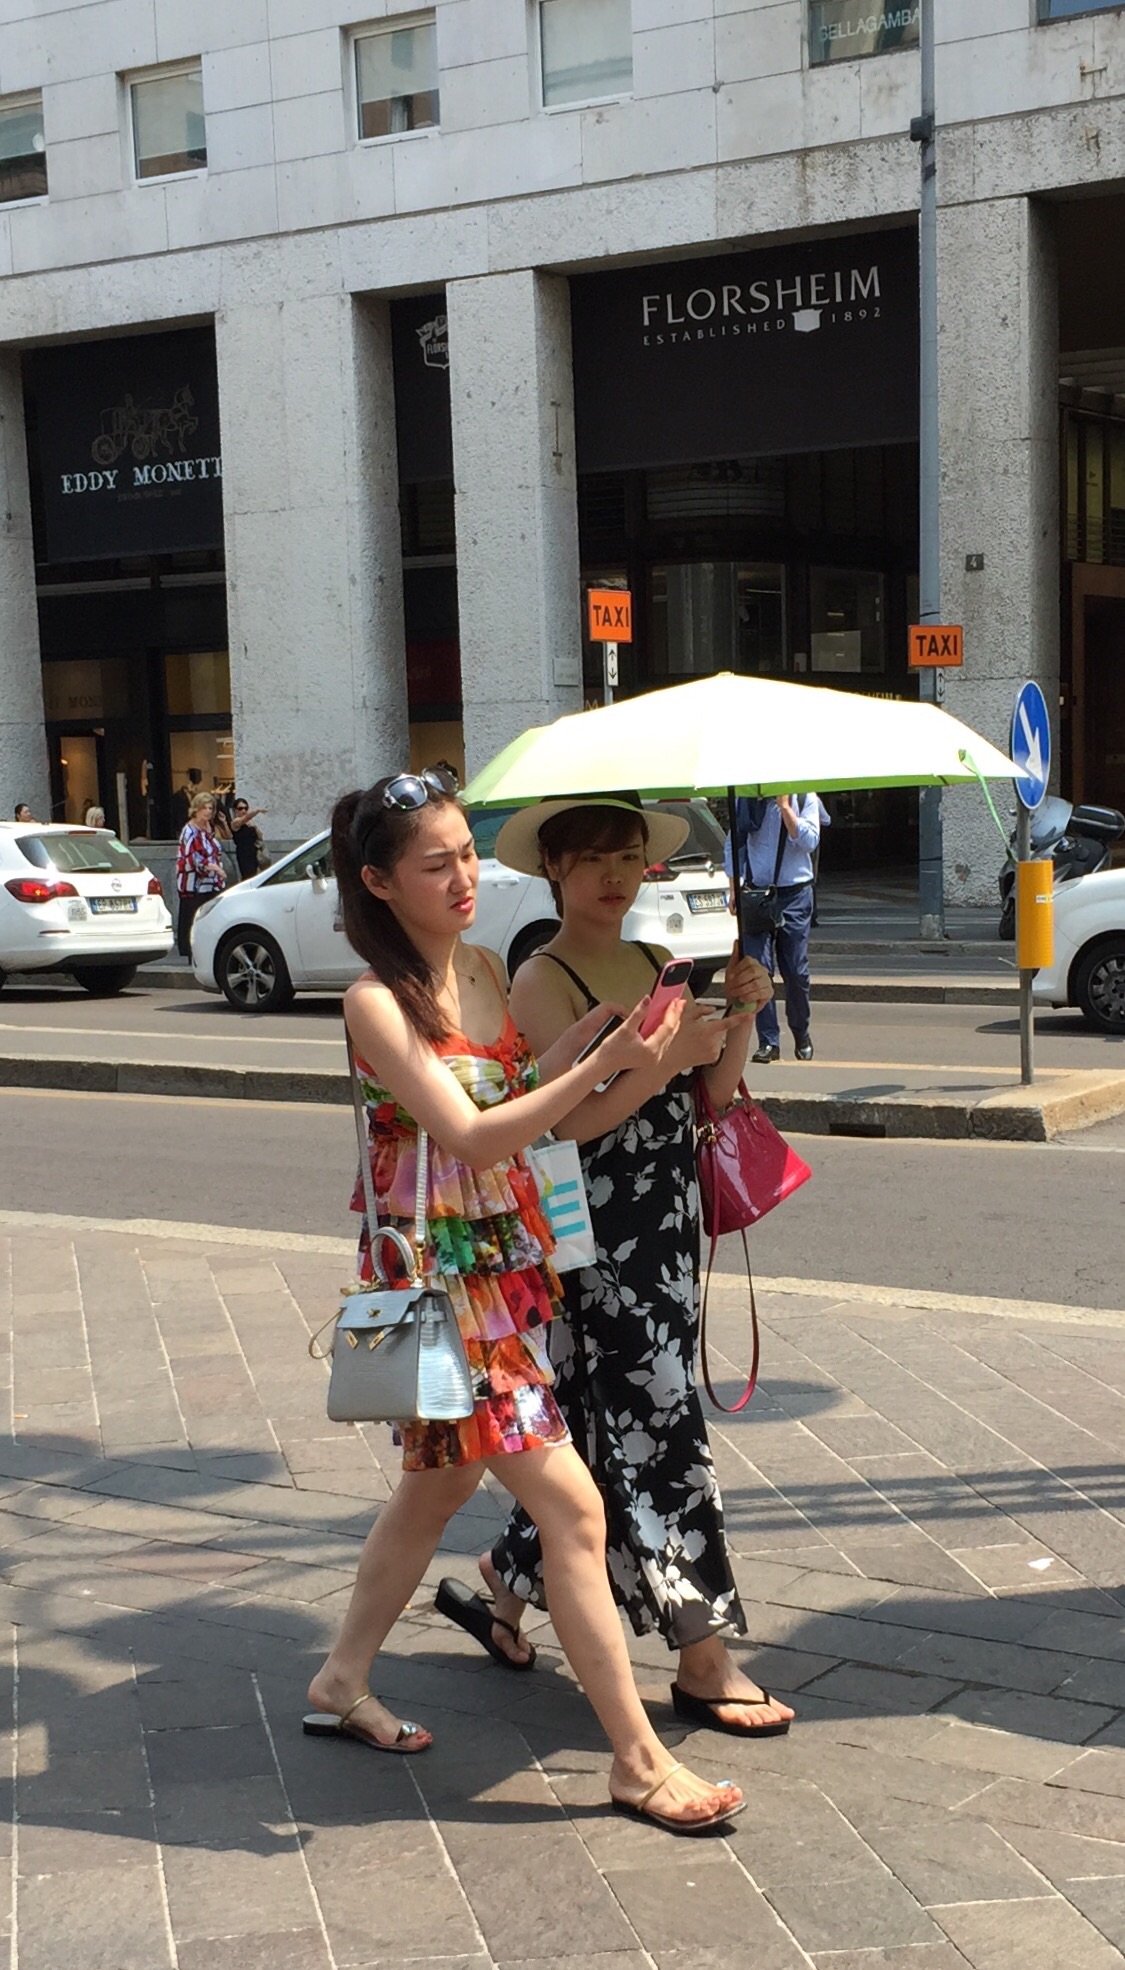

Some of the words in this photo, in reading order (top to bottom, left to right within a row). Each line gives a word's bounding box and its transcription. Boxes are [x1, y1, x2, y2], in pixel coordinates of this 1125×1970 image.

[642, 266, 881, 326] FLORSHEIM
[643, 319, 786, 346] ESTABLISHED
[832, 306, 881, 323] 1892
[61, 469, 119, 494] EDDY
[970, 555, 977, 568] 4
[592, 604, 630, 628] TAXI
[915, 634, 958, 657] TAXI
